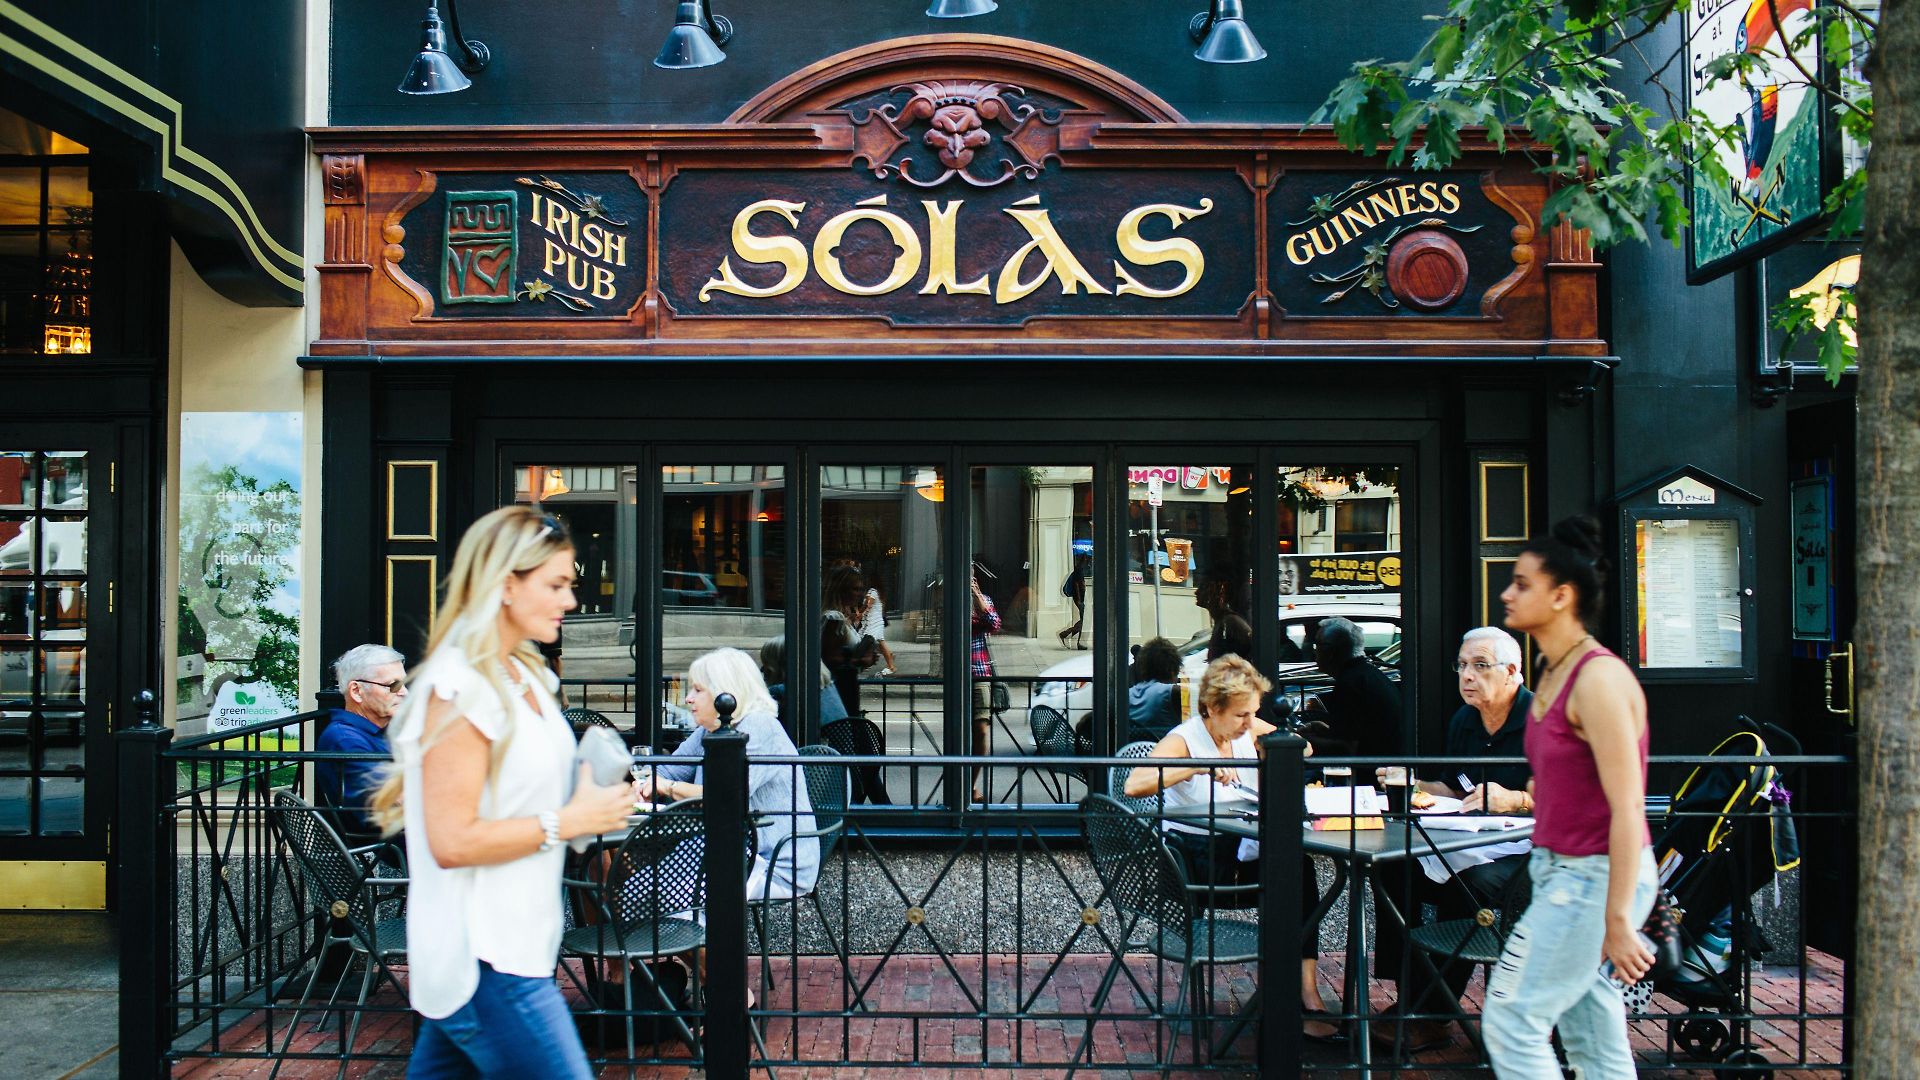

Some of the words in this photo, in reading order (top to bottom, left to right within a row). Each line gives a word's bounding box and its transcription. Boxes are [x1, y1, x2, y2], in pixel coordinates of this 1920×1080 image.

[530, 191, 627, 267] IRISH
[1286, 181, 1461, 265] GUINNESS
[542, 237, 617, 300] PUB
[699, 194, 1214, 304] SÓLÁS
[217, 485, 259, 506] doing
[263, 491, 287, 502] our
[232, 521, 263, 537] part
[265, 518, 288, 533] for
[214, 550, 238, 565] the
[242, 550, 289, 565] future
[220, 706, 278, 717] greenleaders
